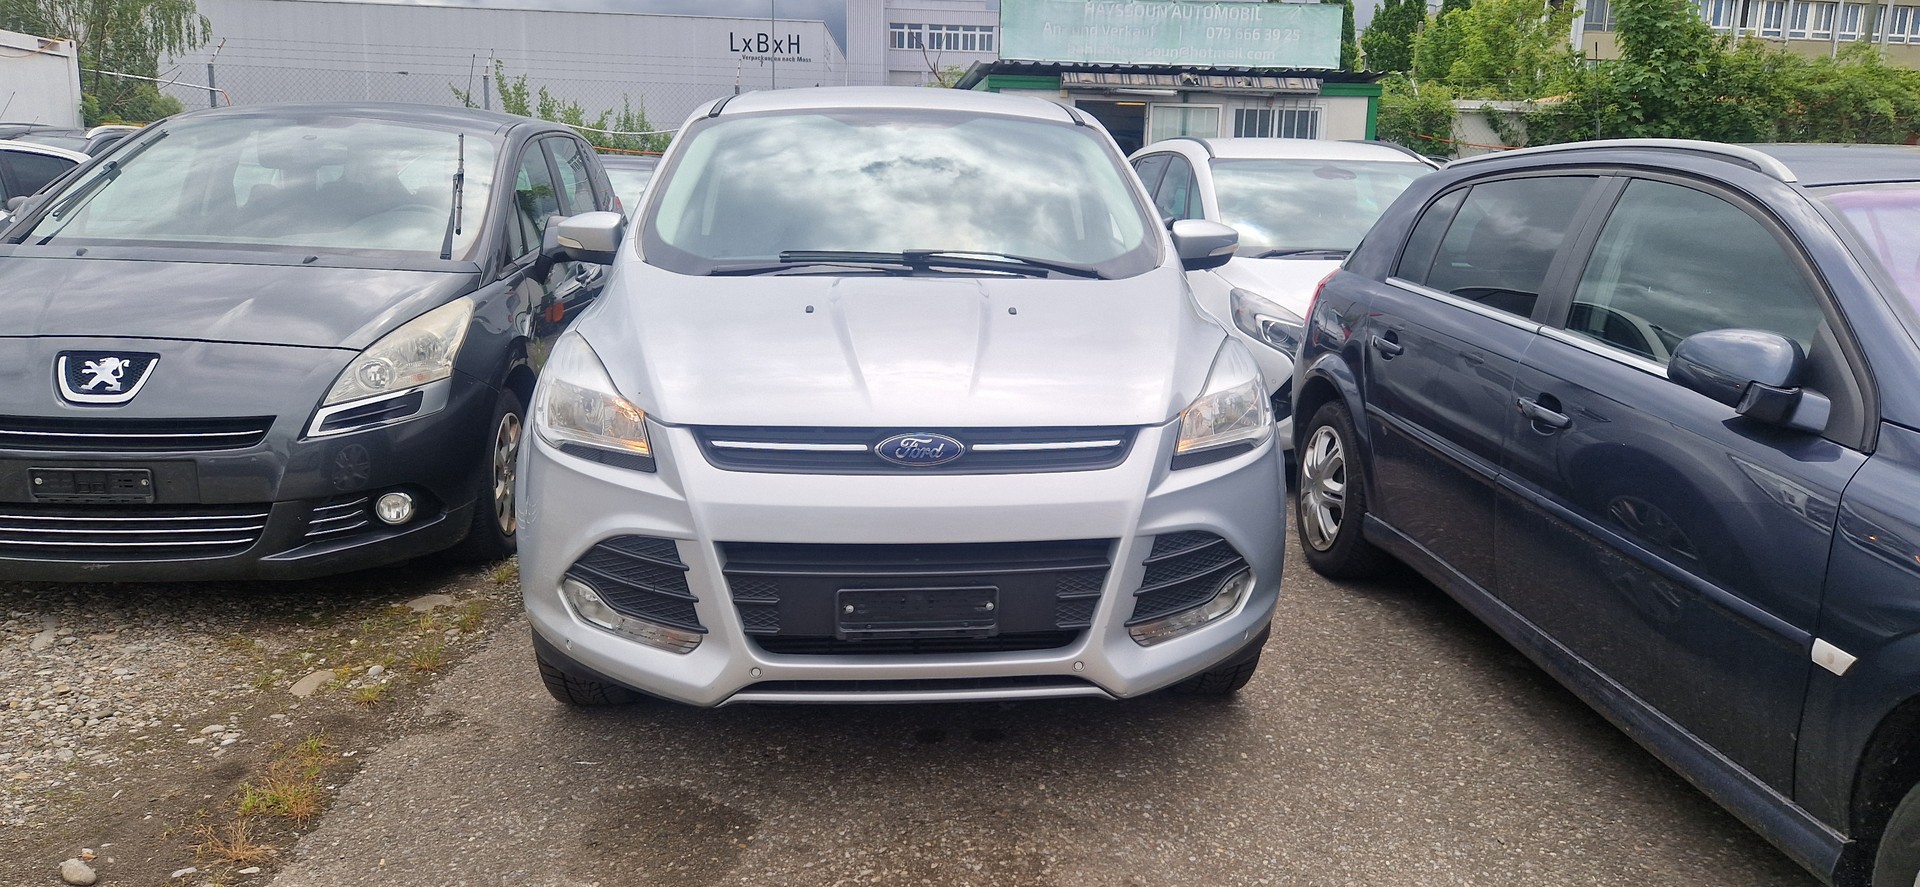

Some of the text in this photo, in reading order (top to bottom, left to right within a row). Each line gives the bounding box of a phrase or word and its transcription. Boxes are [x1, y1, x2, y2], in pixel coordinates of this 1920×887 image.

[1084, 3, 1263, 20] HAYSSOUN AUTOMOBIL
[1072, 24, 1098, 36] und
[1102, 24, 1156, 38] Verkauf
[1206, 27, 1300, 40] 079 666 39 25
[895, 437, 945, 459] Ford
